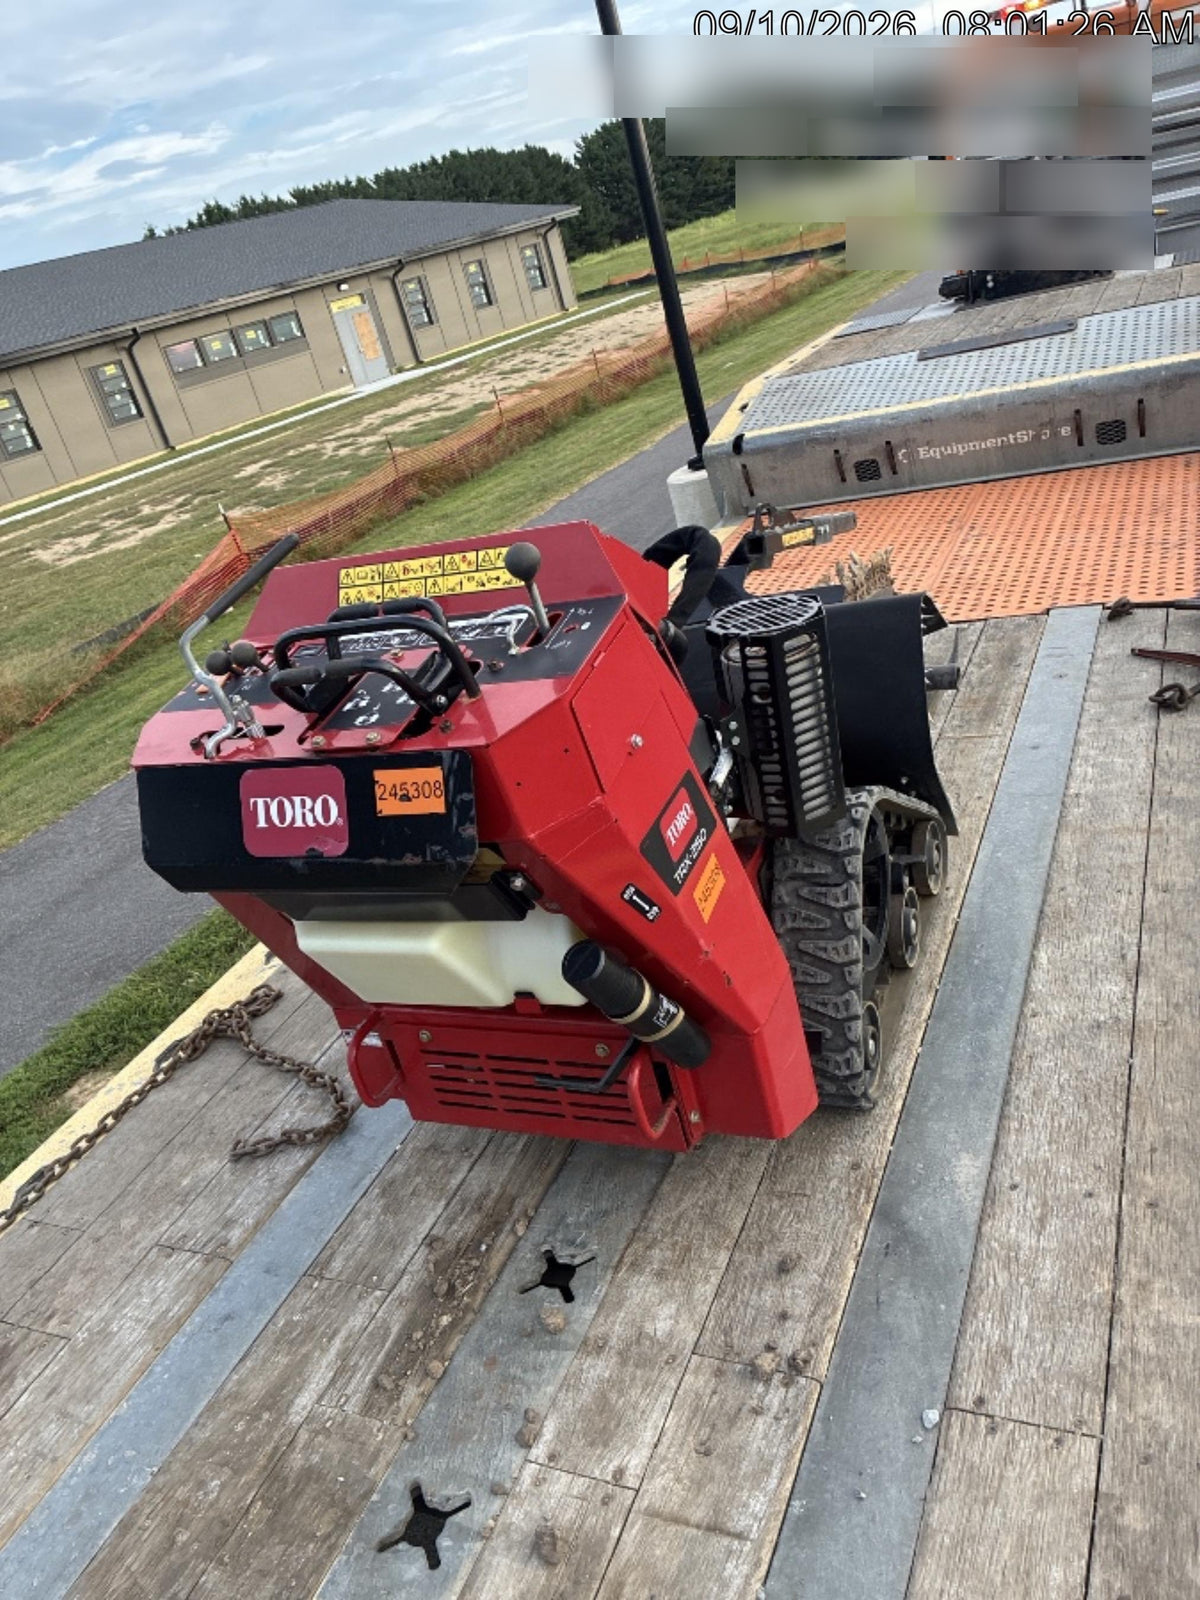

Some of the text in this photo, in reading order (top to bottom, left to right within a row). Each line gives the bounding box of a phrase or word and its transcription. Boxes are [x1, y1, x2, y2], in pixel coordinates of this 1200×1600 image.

[917, 425, 1071, 459] EquipmentShe
[377, 780, 444, 801] 245308
[250, 794, 339, 828] TORO
